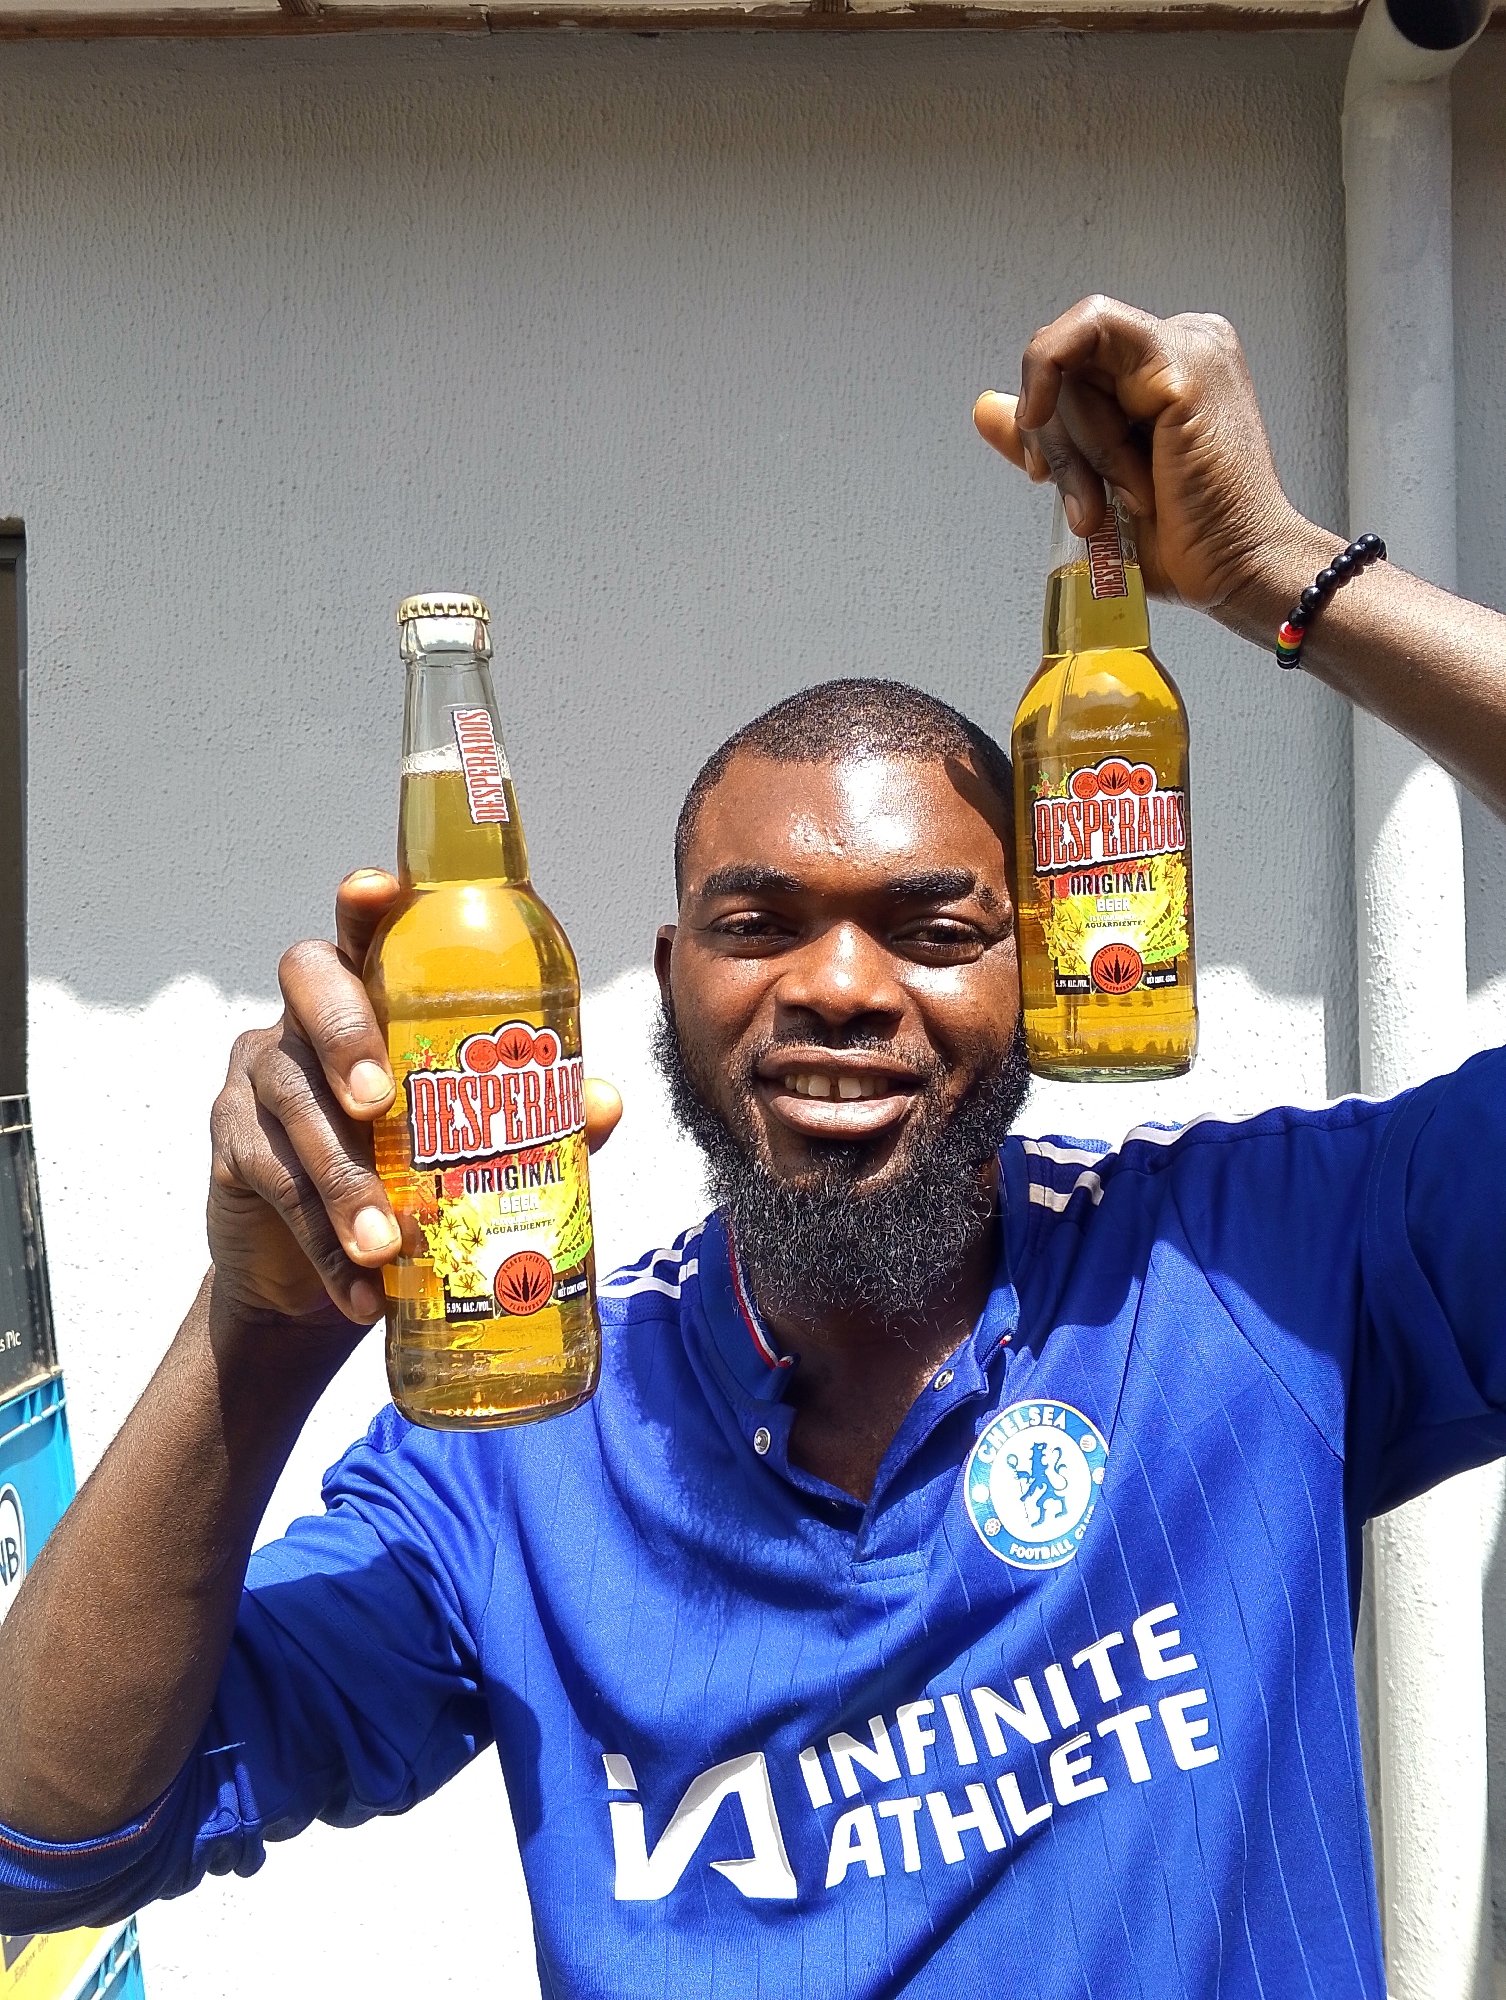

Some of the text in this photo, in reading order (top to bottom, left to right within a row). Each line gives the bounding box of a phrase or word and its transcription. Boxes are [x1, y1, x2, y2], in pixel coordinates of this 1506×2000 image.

[456, 710, 508, 821] DESPERADOS
[1036, 795, 1186, 867] DESPERADOS
[1069, 870, 1157, 896] ORIGINAL
[1095, 897, 1131, 913] BEER
[412, 1061, 587, 1158] DESPERADOS
[464, 1159, 566, 1195] ORIGINAL
[499, 1193, 540, 1215] BEER
[446, 1302, 462, 1314] 5.9%
[5, 1329, 22, 1350] Plc
[978, 1406, 1067, 1464] CHELSEA
[1009, 1537, 1075, 1561] FOOTBALL
[798, 1602, 1198, 1810] INFINITE
[824, 1687, 1221, 1890] ATHLETE
